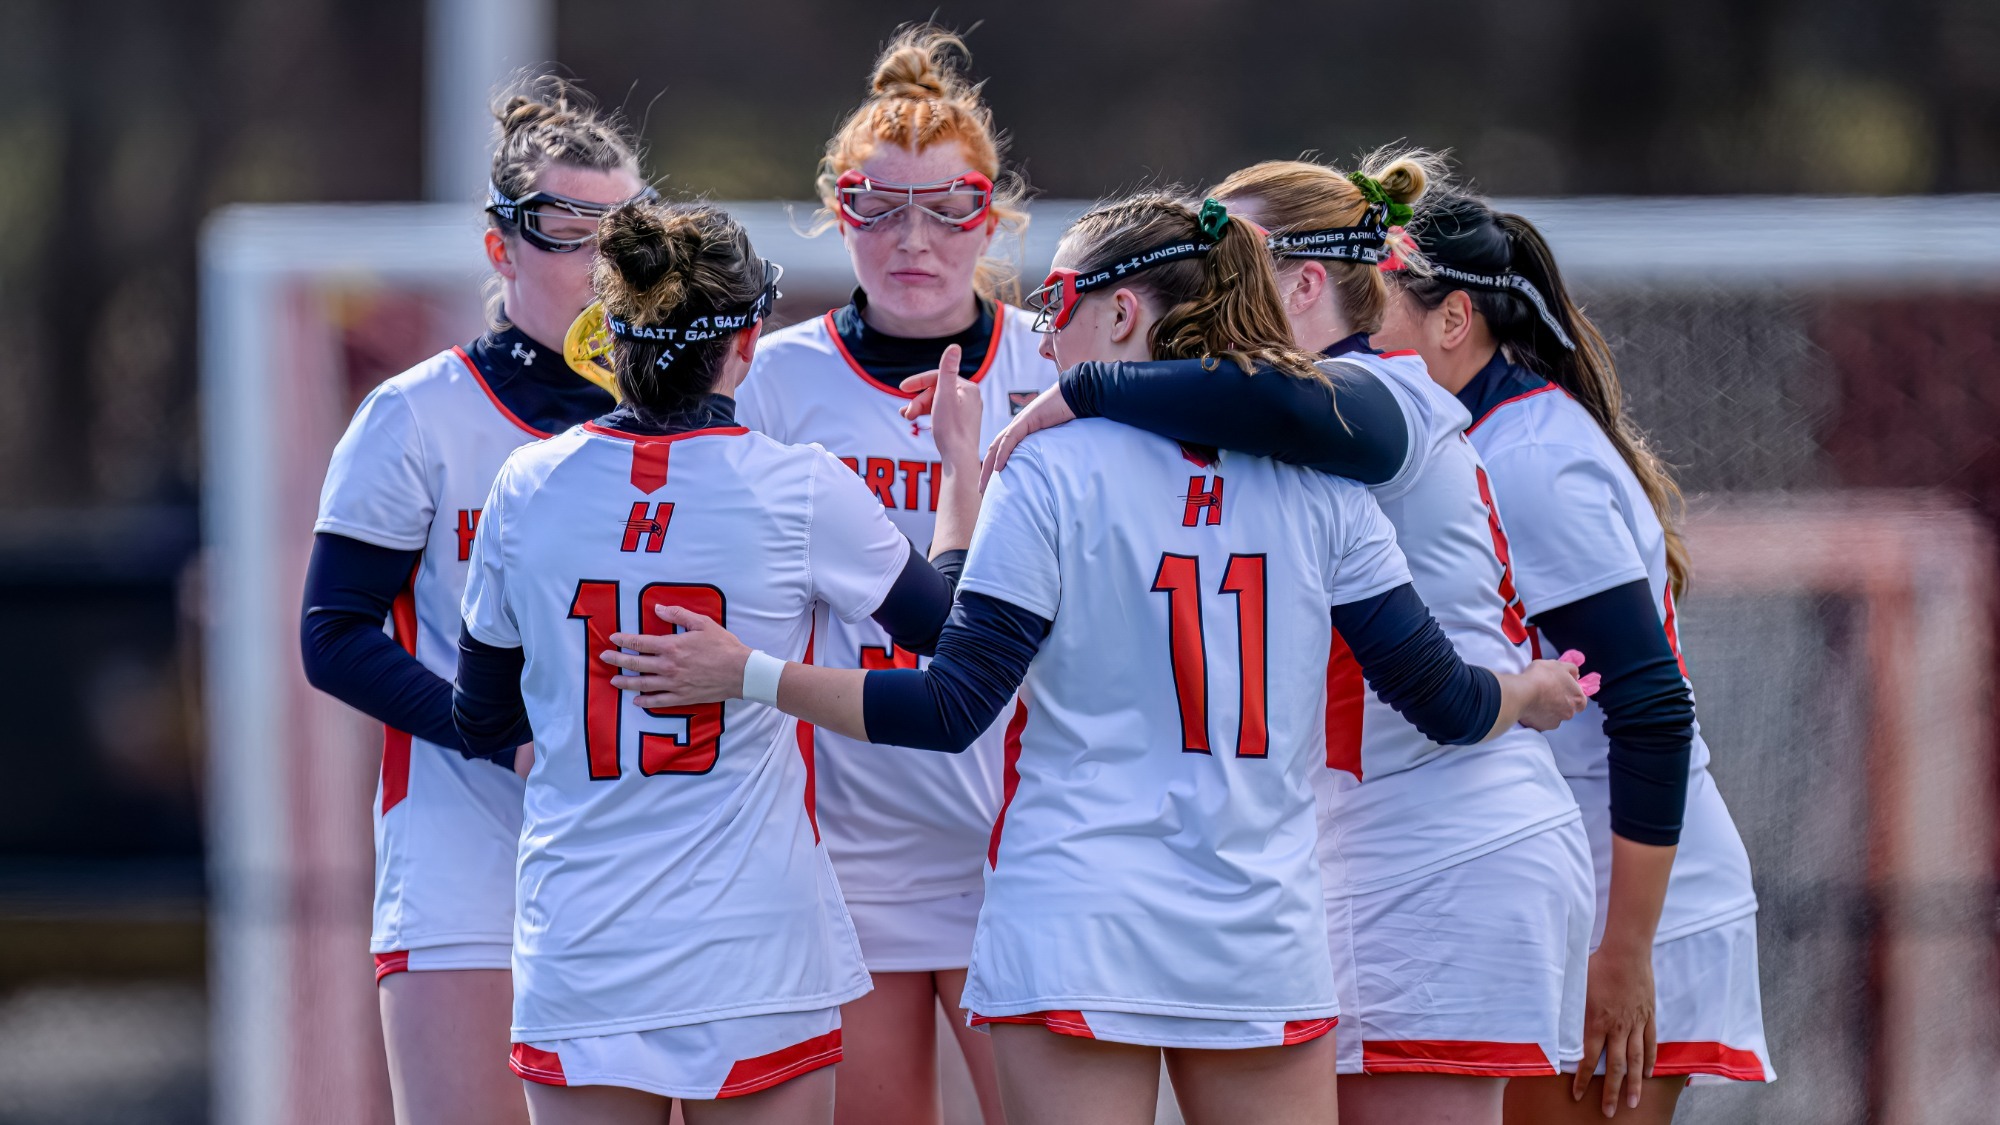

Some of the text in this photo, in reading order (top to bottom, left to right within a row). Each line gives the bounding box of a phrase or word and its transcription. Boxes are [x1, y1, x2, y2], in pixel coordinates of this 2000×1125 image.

[1292, 231, 1345, 247] UNDER
[1142, 243, 1195, 263] UNDER
[1434, 264, 1494, 286] ARMOUR
[714, 314, 748, 329] GAIT
[632, 328, 677, 341] GAIT
[619, 501, 675, 553] H
[1150, 551, 1269, 760] 11
[567, 578, 727, 781] 19
